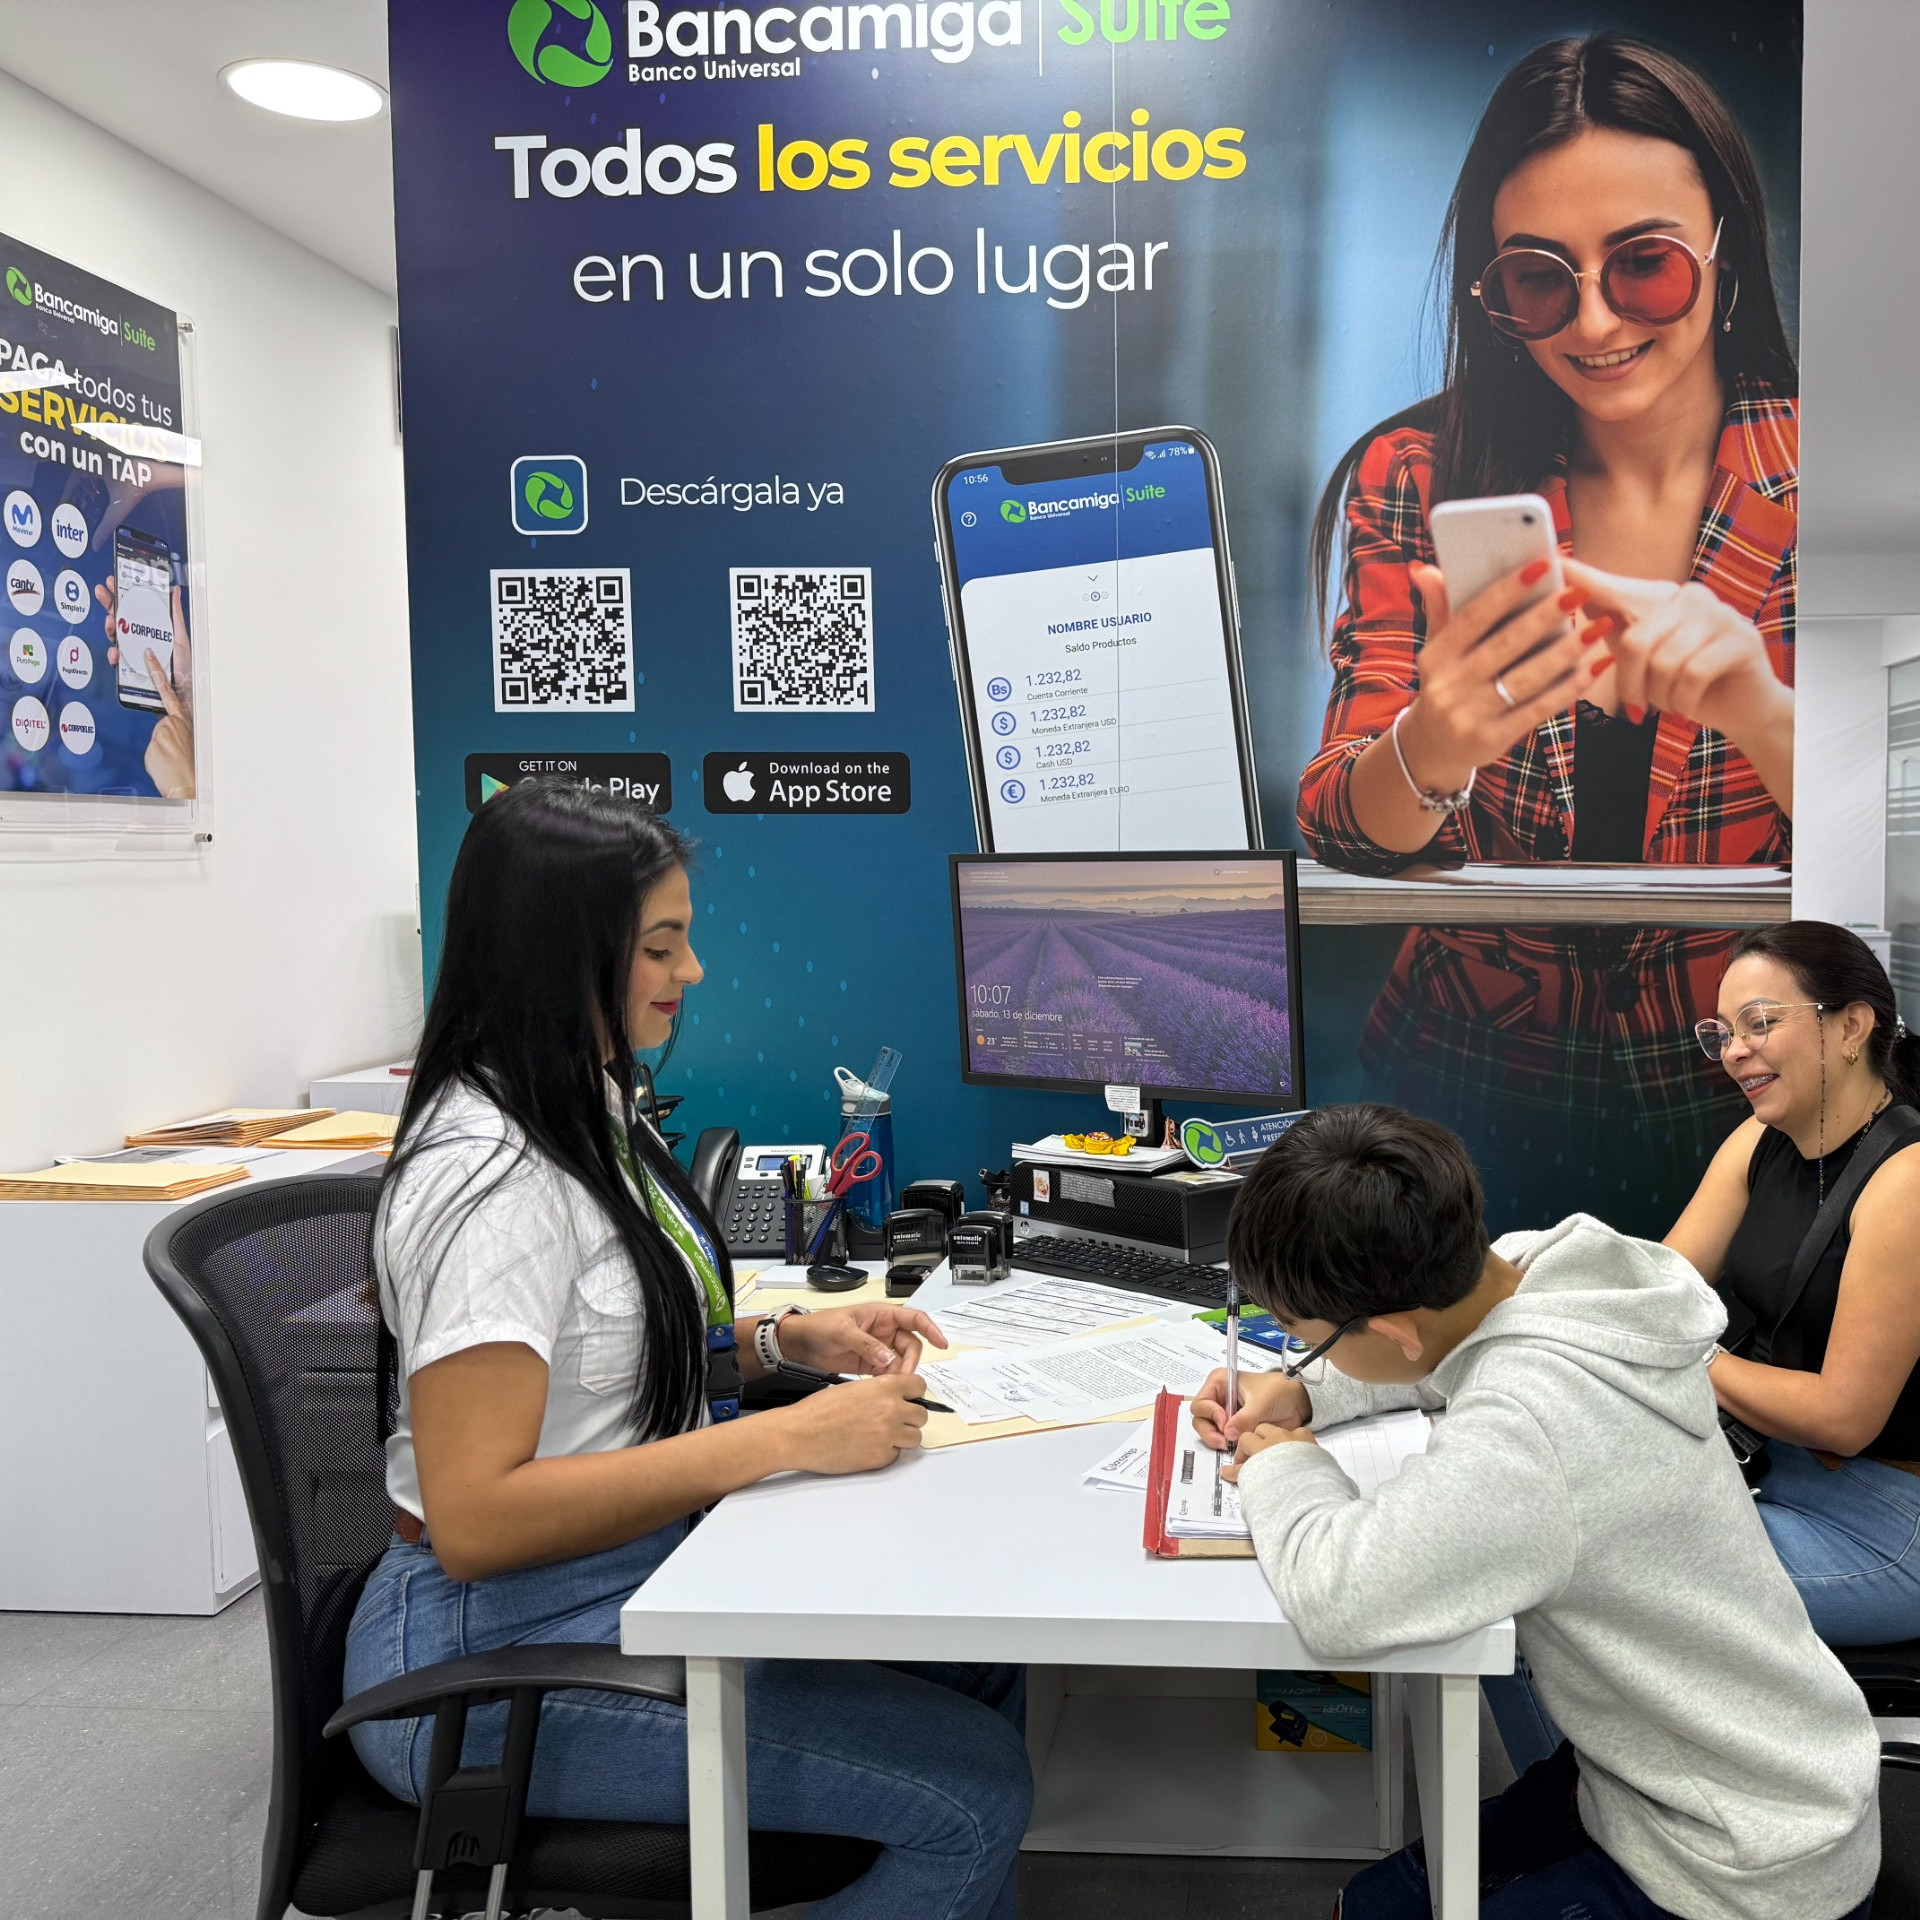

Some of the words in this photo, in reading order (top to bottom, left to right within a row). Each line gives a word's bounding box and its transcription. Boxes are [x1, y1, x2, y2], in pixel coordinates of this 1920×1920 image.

[627, 0, 1021, 64] Bancamiga
[628, 64, 697, 82] Banco
[704, 57, 801, 80] Universal
[495, 128, 737, 199] Todos
[758, 124, 870, 191] los
[889, 109, 1247, 188] servicios
[572, 253, 664, 302] en
[689, 250, 784, 299] un
[805, 230, 953, 298] solo
[977, 228, 1168, 309] lugar
[34, 282, 118, 335] Bancamiga
[123, 322, 156, 351] Suite
[35, 303, 52, 315] Banco
[73, 368, 136, 413] todos
[142, 394, 172, 427] tus
[20, 431, 66, 465] con
[72, 446, 103, 476] un
[108, 452, 152, 488] TAP
[963, 473, 989, 485] 10:56
[1168, 446, 1187, 457] 78%
[620, 475, 800, 512] Descárgala
[807, 481, 844, 511] ya
[1028, 492, 1120, 516] Bancamiga
[1126, 484, 1166, 503] Suite
[56, 519, 85, 542] inter
[10, 578, 35, 591] cantv
[130, 622, 173, 643] CORPOELEC
[1047, 619, 1099, 635] NOMBRE
[1100, 612, 1152, 628] USUARIO
[1065, 643, 1091, 653] Saldo
[1092, 637, 1137, 650] Productos
[991, 684, 1008, 695] Bs
[1025, 668, 1082, 687] 1.232,82
[1027, 692, 1053, 701] Cuenta
[1054, 687, 1088, 698] Corriente
[1030, 704, 1087, 723] 1.232,82
[68, 724, 94, 734] CORPOELEC
[1032, 725, 1062, 735] Moneda
[1063, 720, 1099, 732] Extranjera
[1100, 718, 1117, 727] USD
[1035, 740, 1091, 758] 1.232,82
[519, 760, 543, 772] GET
[545, 760, 555, 772] IT
[558, 760, 577, 772] ON
[769, 762, 840, 774] Download
[844, 764, 862, 774] on
[867, 762, 890, 774] the
[1036, 760, 1055, 769] Cash
[1056, 758, 1073, 767] USD
[609, 777, 660, 804] Play
[1040, 772, 1095, 790] 1.232,82
[769, 779, 821, 808] App
[825, 779, 892, 802] Store
[1041, 793, 1071, 803] Moneda
[1072, 789, 1108, 801] Extranjera
[1109, 785, 1130, 795] EURO
[970, 984, 1011, 1004] 10:07
[1002, 1009, 1010, 1019] 13
[1012, 1010, 1023, 1020] de
[1024, 1010, 1063, 1022] diciembre
